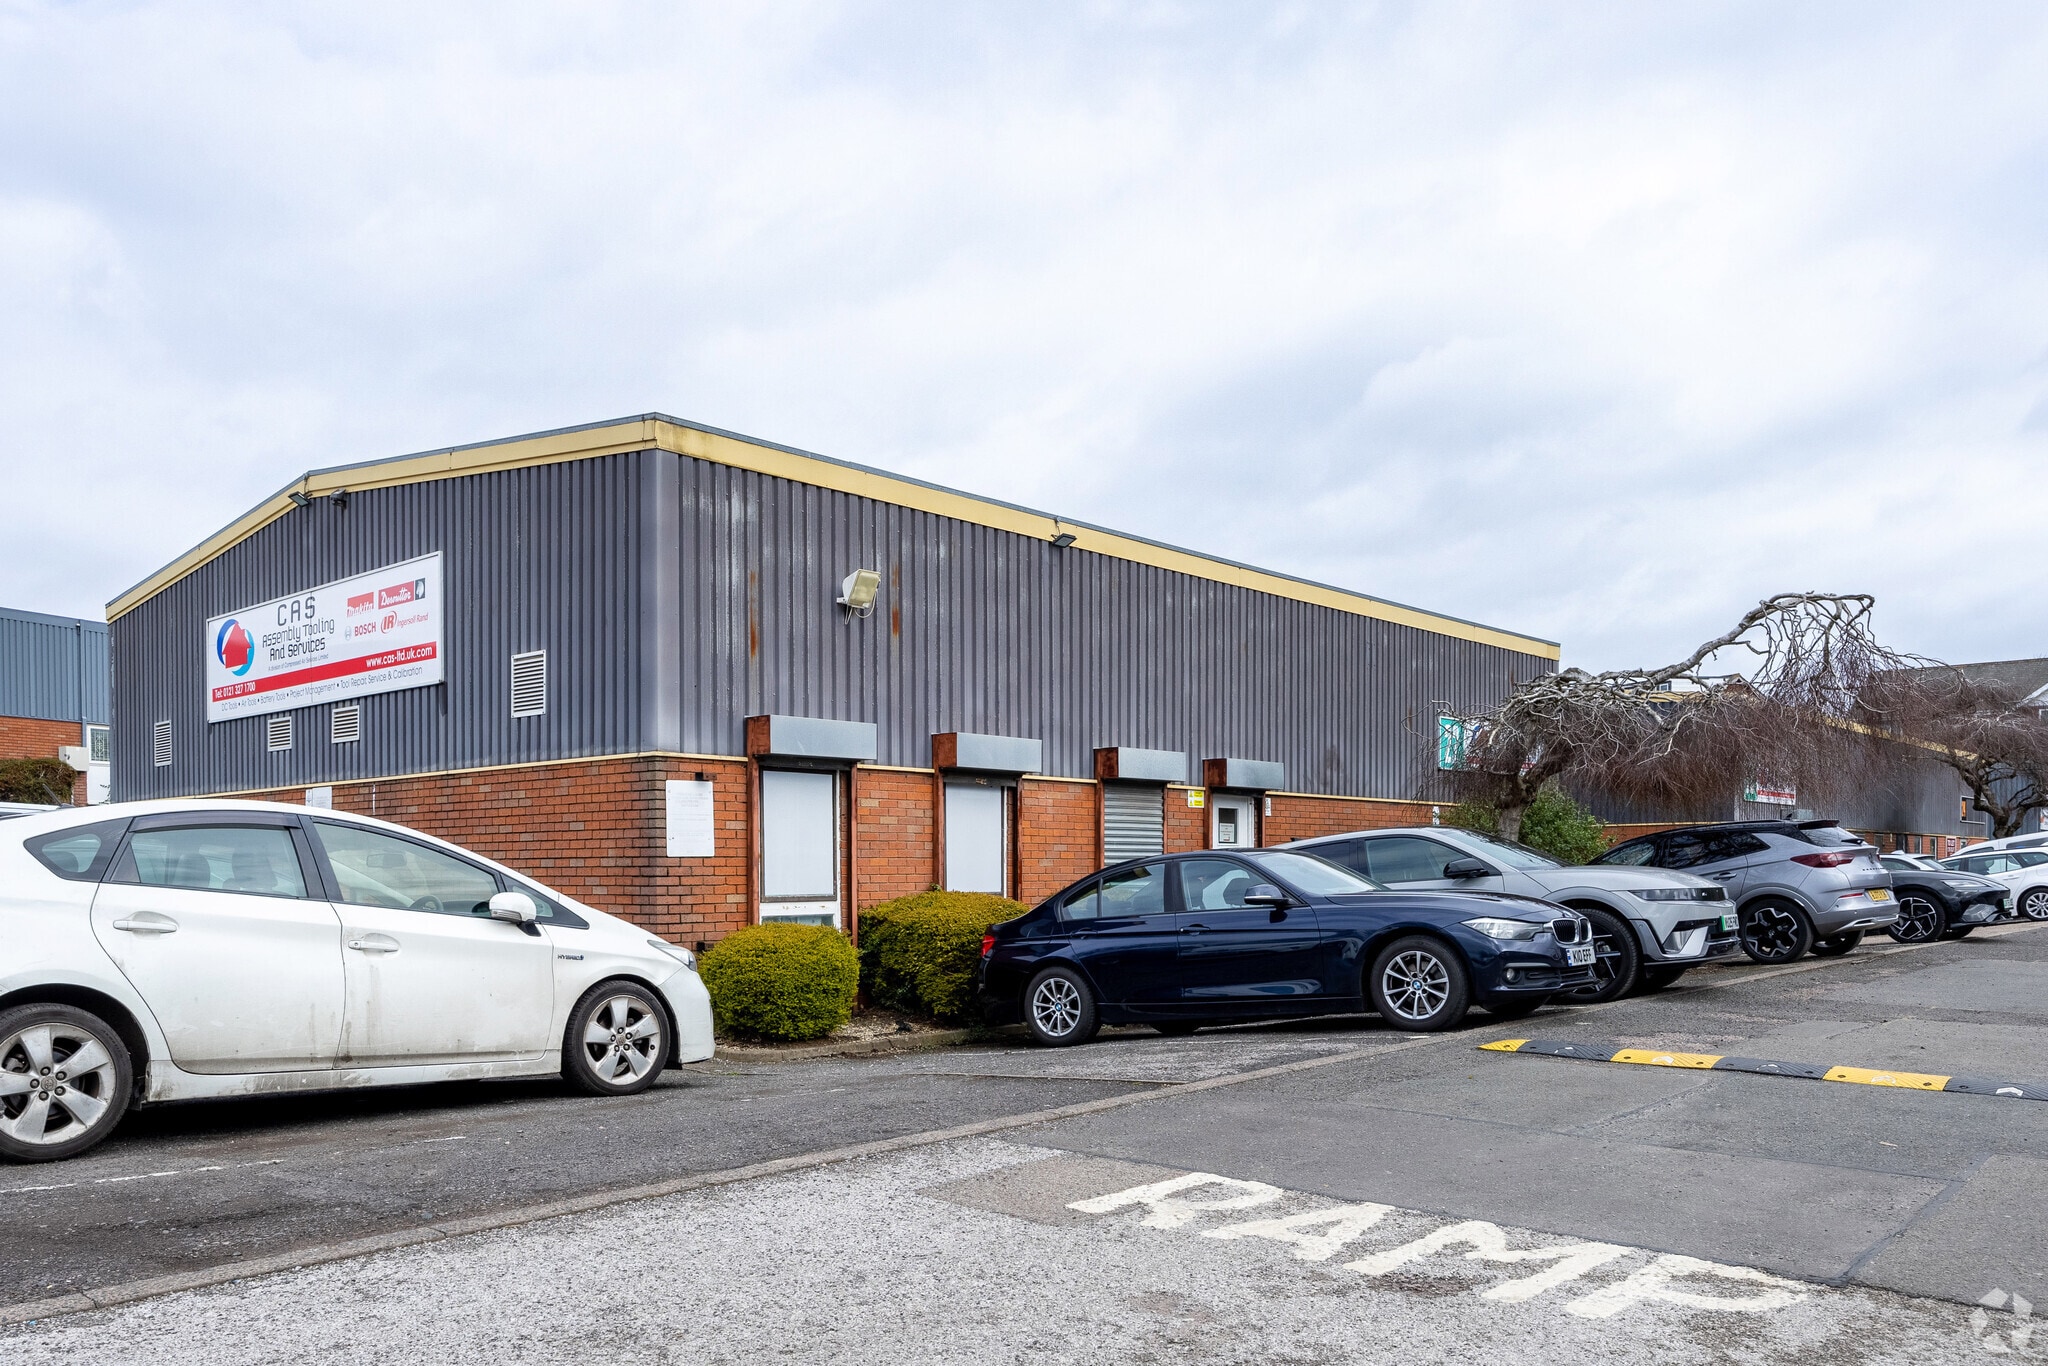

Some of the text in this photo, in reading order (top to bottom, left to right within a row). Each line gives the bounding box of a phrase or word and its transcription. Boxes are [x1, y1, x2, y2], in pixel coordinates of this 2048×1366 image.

[277, 596, 316, 627] CAS
[397, 612, 429, 628] Ingersoll Rand
[262, 617, 335, 648] Assembly Tooling
[354, 621, 377, 637] BOSCH
[269, 637, 326, 662] And Services
[365, 646, 433, 668] www.cas-ltd.uk.com
[223, 685, 234, 697] 0121
[234, 683, 244, 695] 327
[244, 681, 256, 693] 1700
[228, 701, 238, 710] Tools
[260, 694, 275, 704] Battery
[275, 692, 286, 702] Tools
[289, 689, 305, 700] Project
[305, 682, 336, 696] Management
[340, 679, 350, 689] Tool
[350, 676, 367, 688] Repair
[367, 672, 387, 684] Service
[392, 666, 423, 680] Calibration
[1065, 1172, 1806, 1318] RAMP
